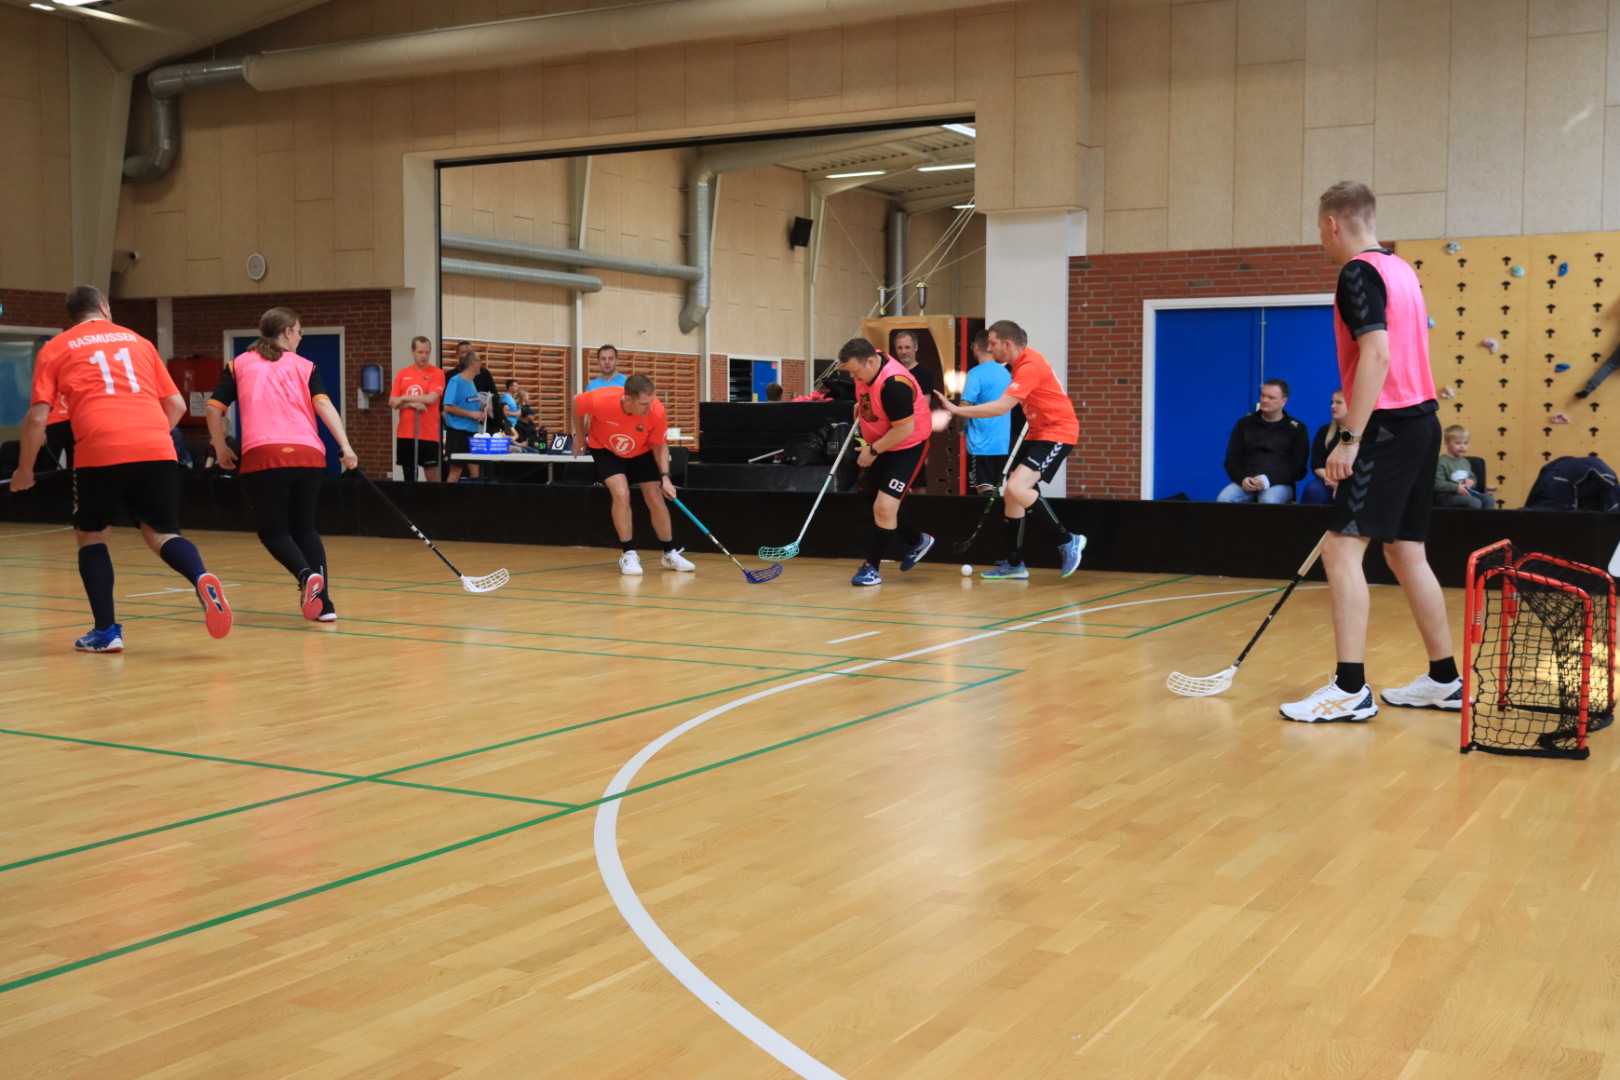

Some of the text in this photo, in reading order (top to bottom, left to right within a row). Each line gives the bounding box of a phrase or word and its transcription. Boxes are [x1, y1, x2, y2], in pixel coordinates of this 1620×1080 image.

[68, 332, 137, 349] RASMUSSEN
[89, 347, 140, 394] 11
[888, 478, 906, 493] 03
